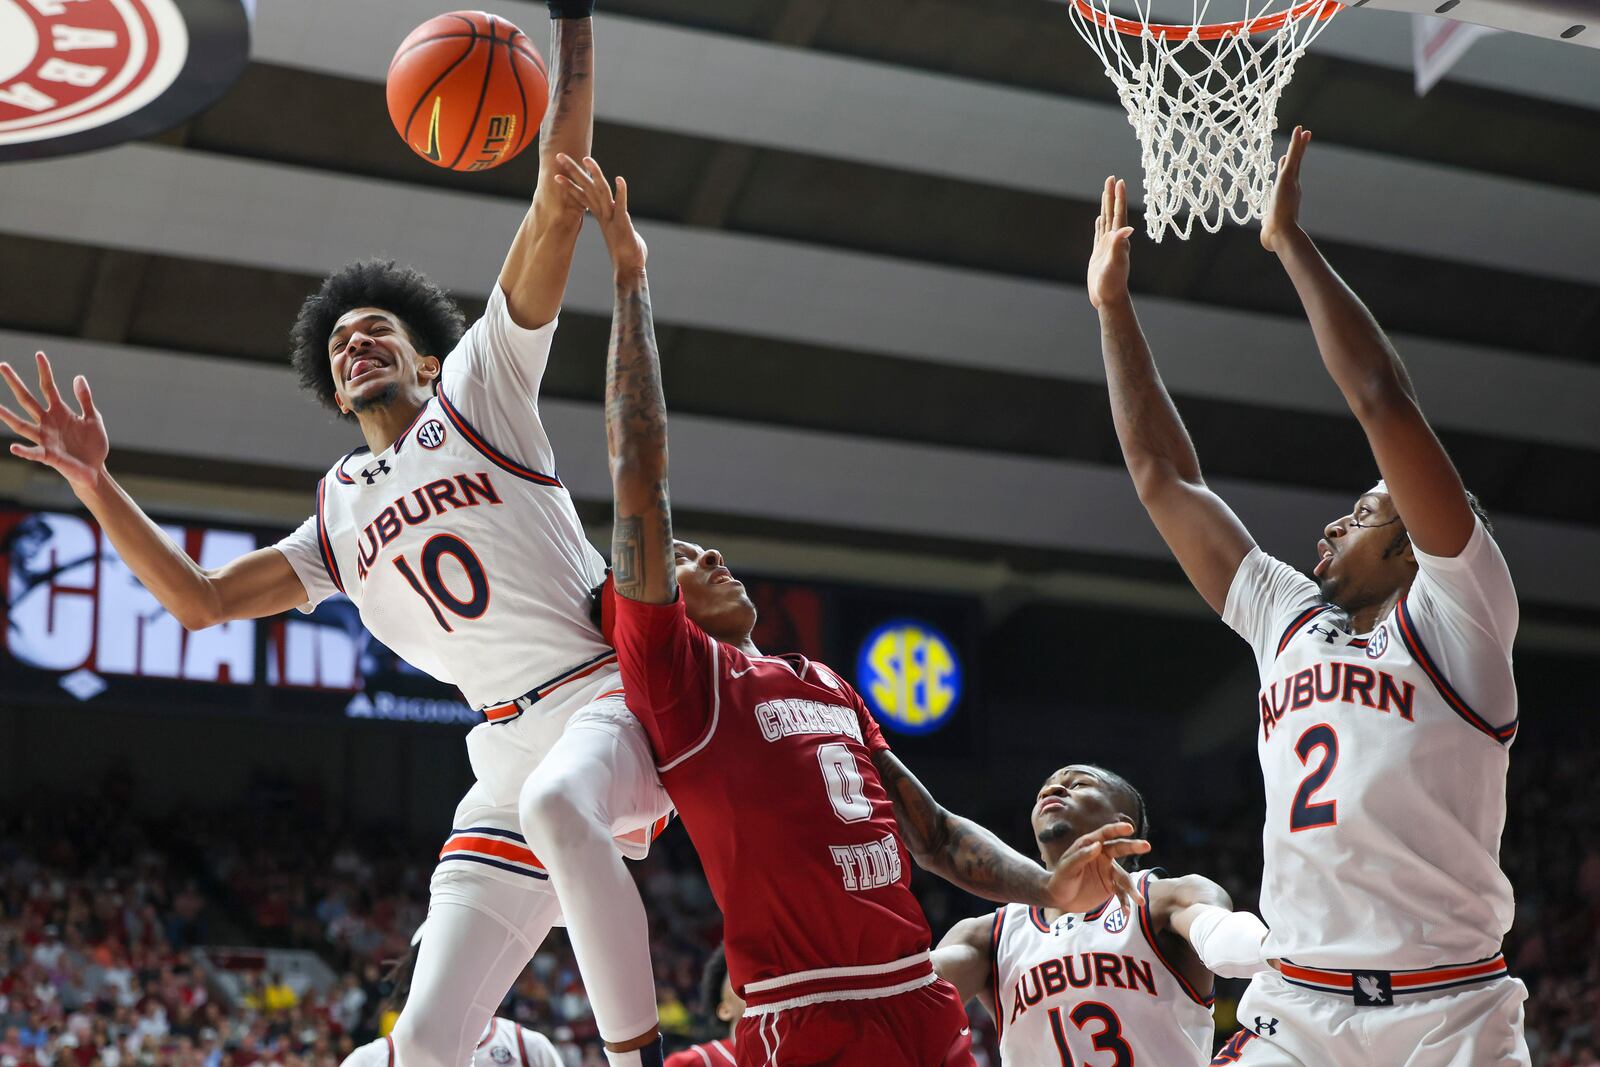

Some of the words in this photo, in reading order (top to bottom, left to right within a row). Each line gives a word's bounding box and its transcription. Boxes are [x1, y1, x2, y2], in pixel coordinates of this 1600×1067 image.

[418, 421, 445, 449] SEC
[357, 472, 503, 581] AUBURN
[392, 533, 490, 634] 10
[866, 626, 956, 725] SEC
[1260, 662, 1415, 742] AUBURN
[817, 742, 873, 824] 0
[1290, 722, 1339, 833] 2
[829, 833, 901, 891] TIDE
[1010, 952, 1158, 1025] AUBURN
[1048, 1001, 1135, 1067] 13
